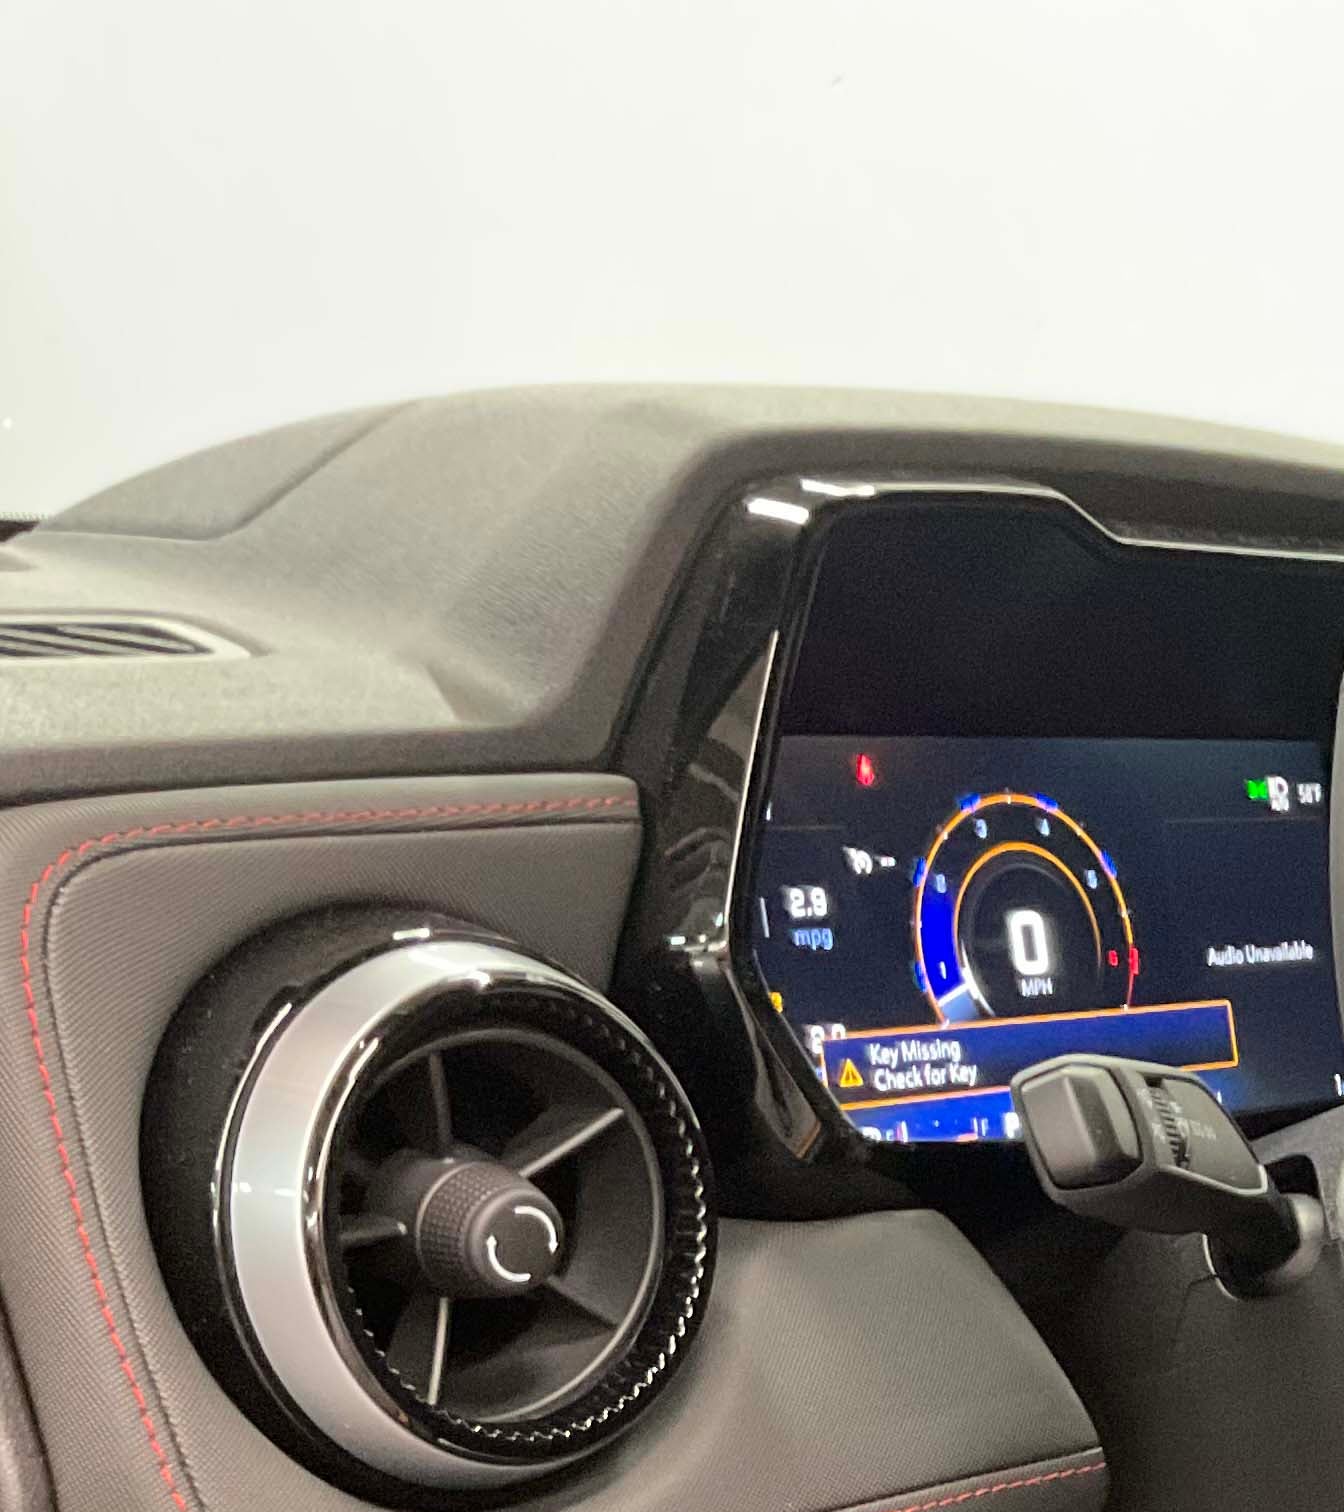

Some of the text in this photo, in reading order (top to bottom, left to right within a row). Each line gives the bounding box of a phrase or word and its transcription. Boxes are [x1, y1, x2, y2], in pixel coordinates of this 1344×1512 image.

[792, 928, 834, 951] mpg
[1008, 910, 1050, 977] 0
[1206, 939, 1315, 967] Audio Unavailable
[1018, 976, 1053, 997] MPH
[869, 1038, 962, 1070] Key Missing
[873, 1063, 978, 1092] Check for Key
